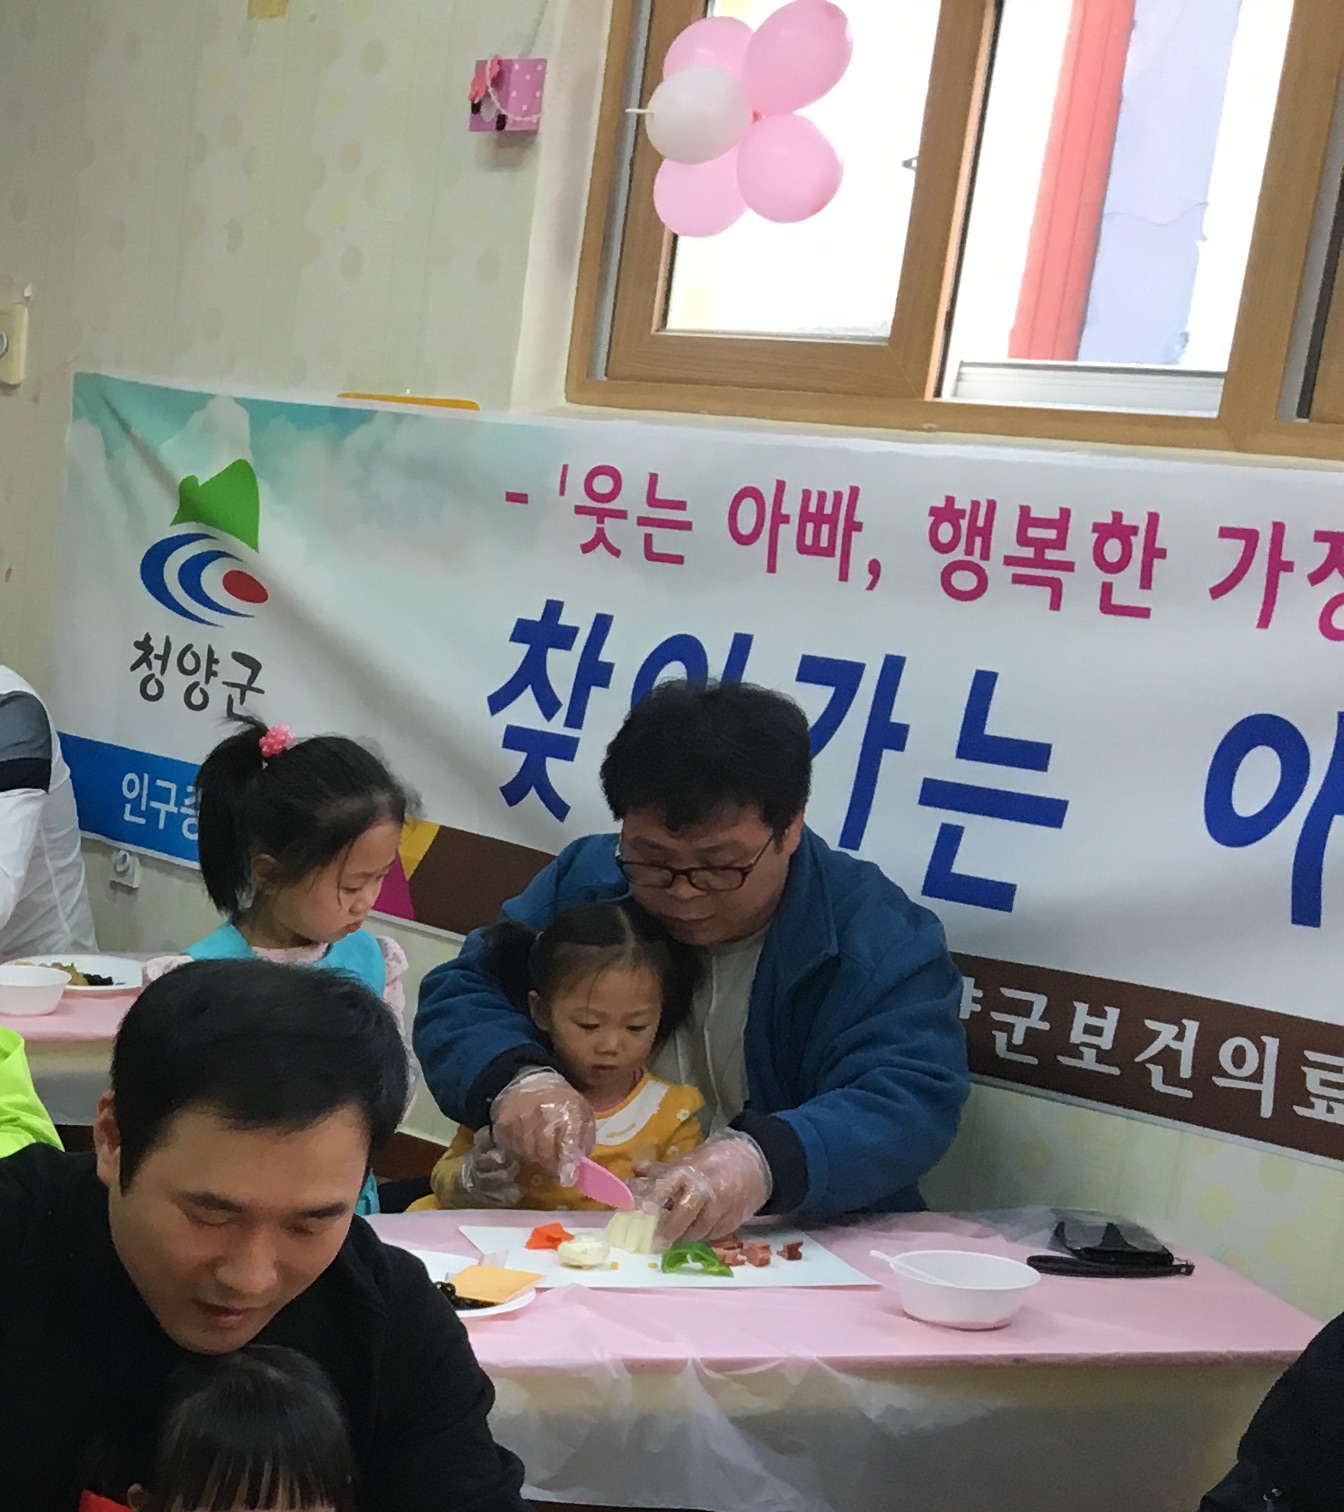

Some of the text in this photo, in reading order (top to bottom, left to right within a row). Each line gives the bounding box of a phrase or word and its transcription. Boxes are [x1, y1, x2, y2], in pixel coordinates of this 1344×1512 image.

[727, 479, 882, 591] 아빠,
[927, 495, 1168, 619] 행복한
[129, 632, 266, 719] 청양군
